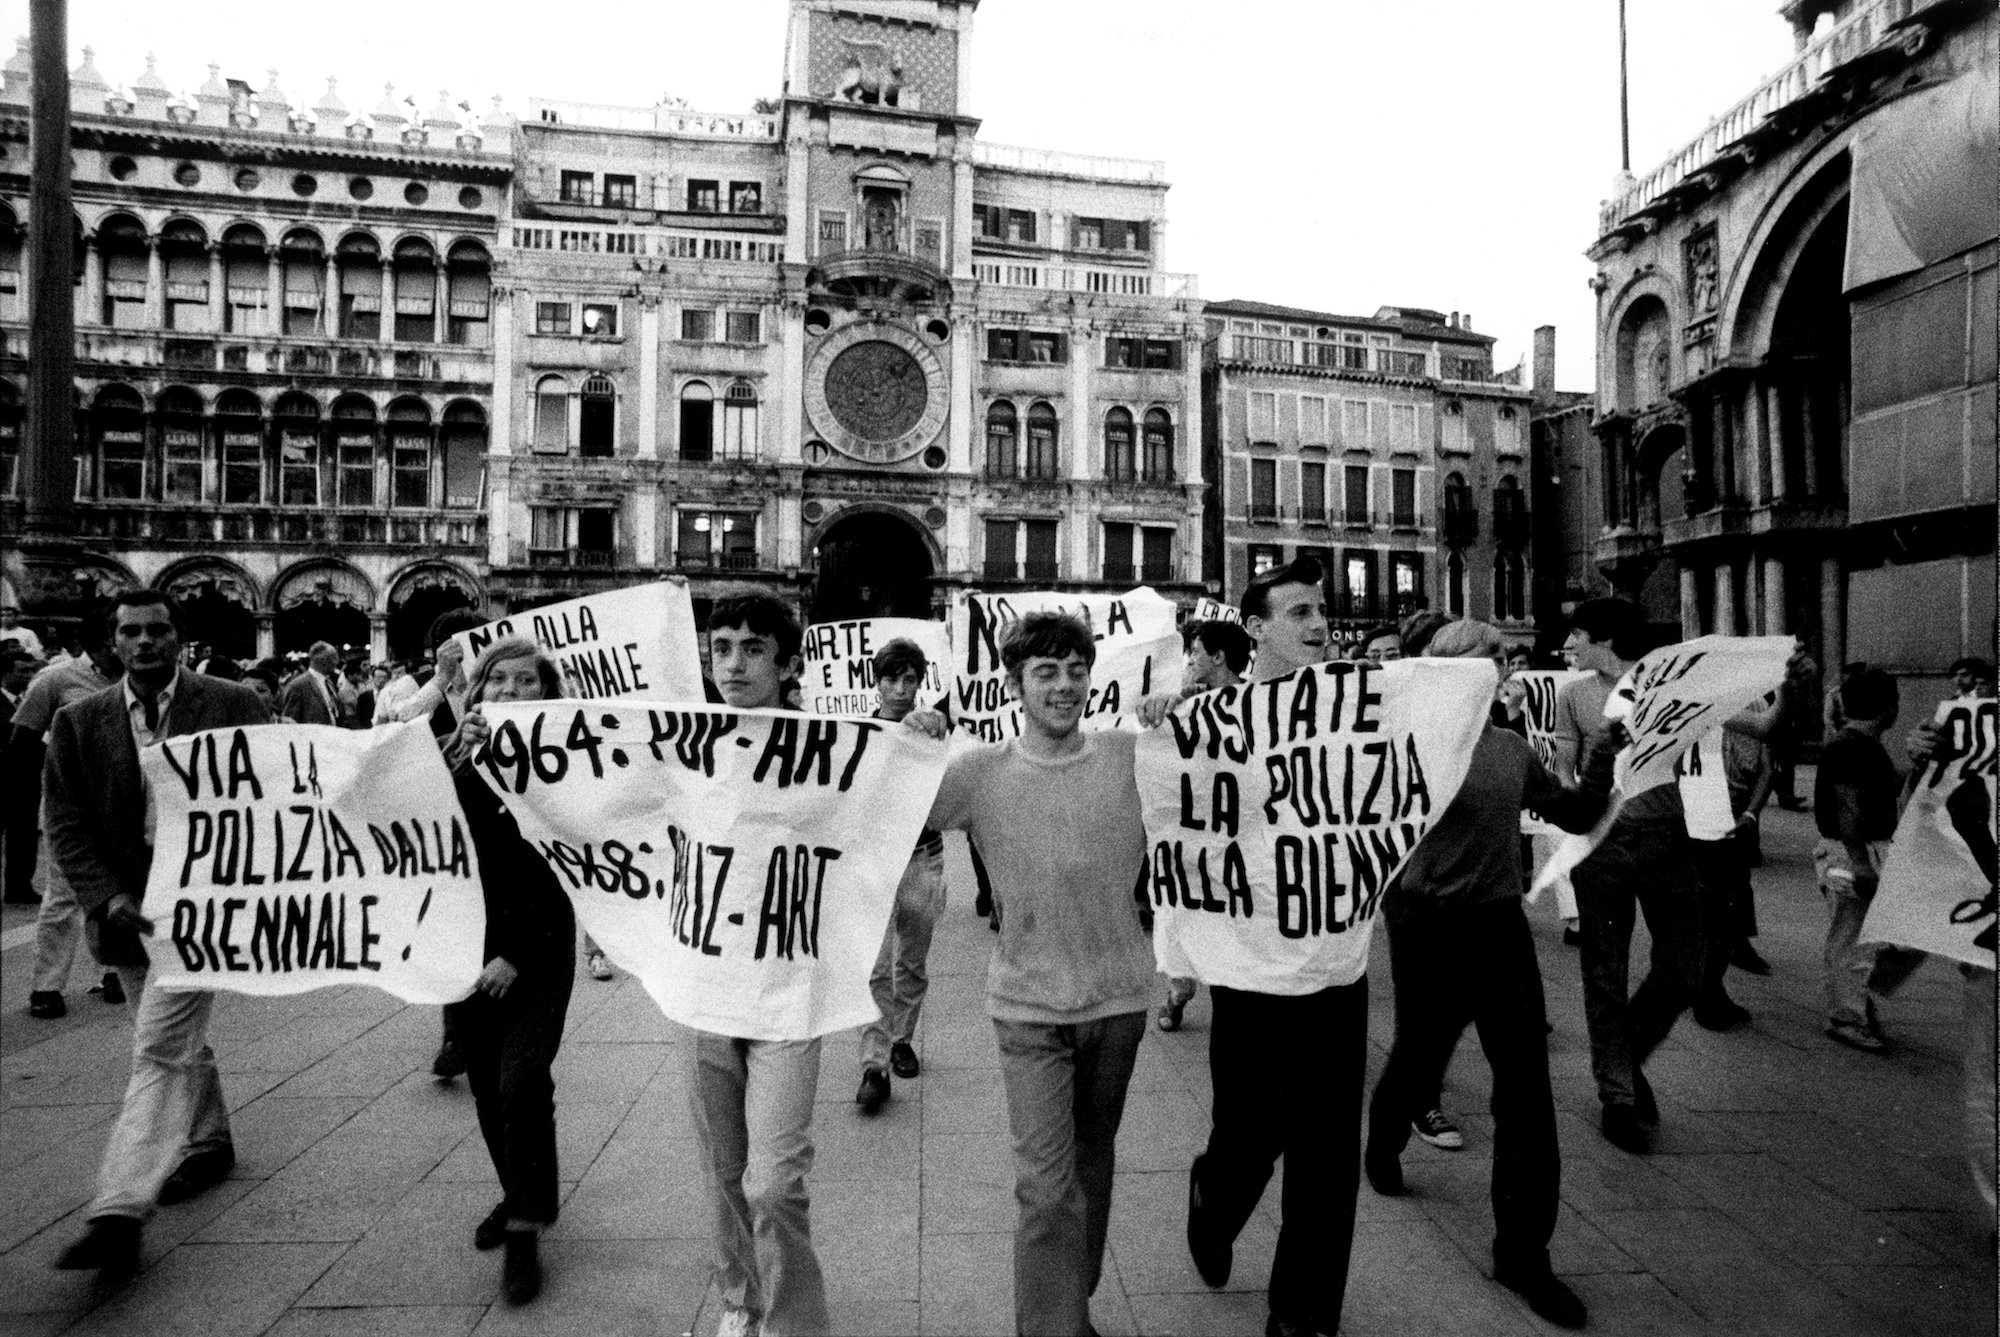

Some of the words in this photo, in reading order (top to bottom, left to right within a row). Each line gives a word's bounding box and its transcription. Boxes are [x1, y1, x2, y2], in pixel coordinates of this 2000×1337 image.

[533, 606, 598, 650] ALLA
[806, 622, 873, 661] ARTE
[1325, 629, 1364, 642] ONS
[823, 664, 832, 687] E
[474, 709, 630, 794] 1964:
[1167, 662, 1384, 766] VISITATE
[162, 728, 263, 800] VIA
[289, 741, 323, 799] LA
[1180, 772, 1240, 838] LA
[1263, 732, 1431, 829] POLIZIA
[180, 805, 366, 888] POLIZIA
[367, 814, 471, 879] DALLA
[538, 839, 665, 900] 1968:
[1153, 840, 1254, 920] ALLA
[171, 891, 381, 973] BIENNALE
